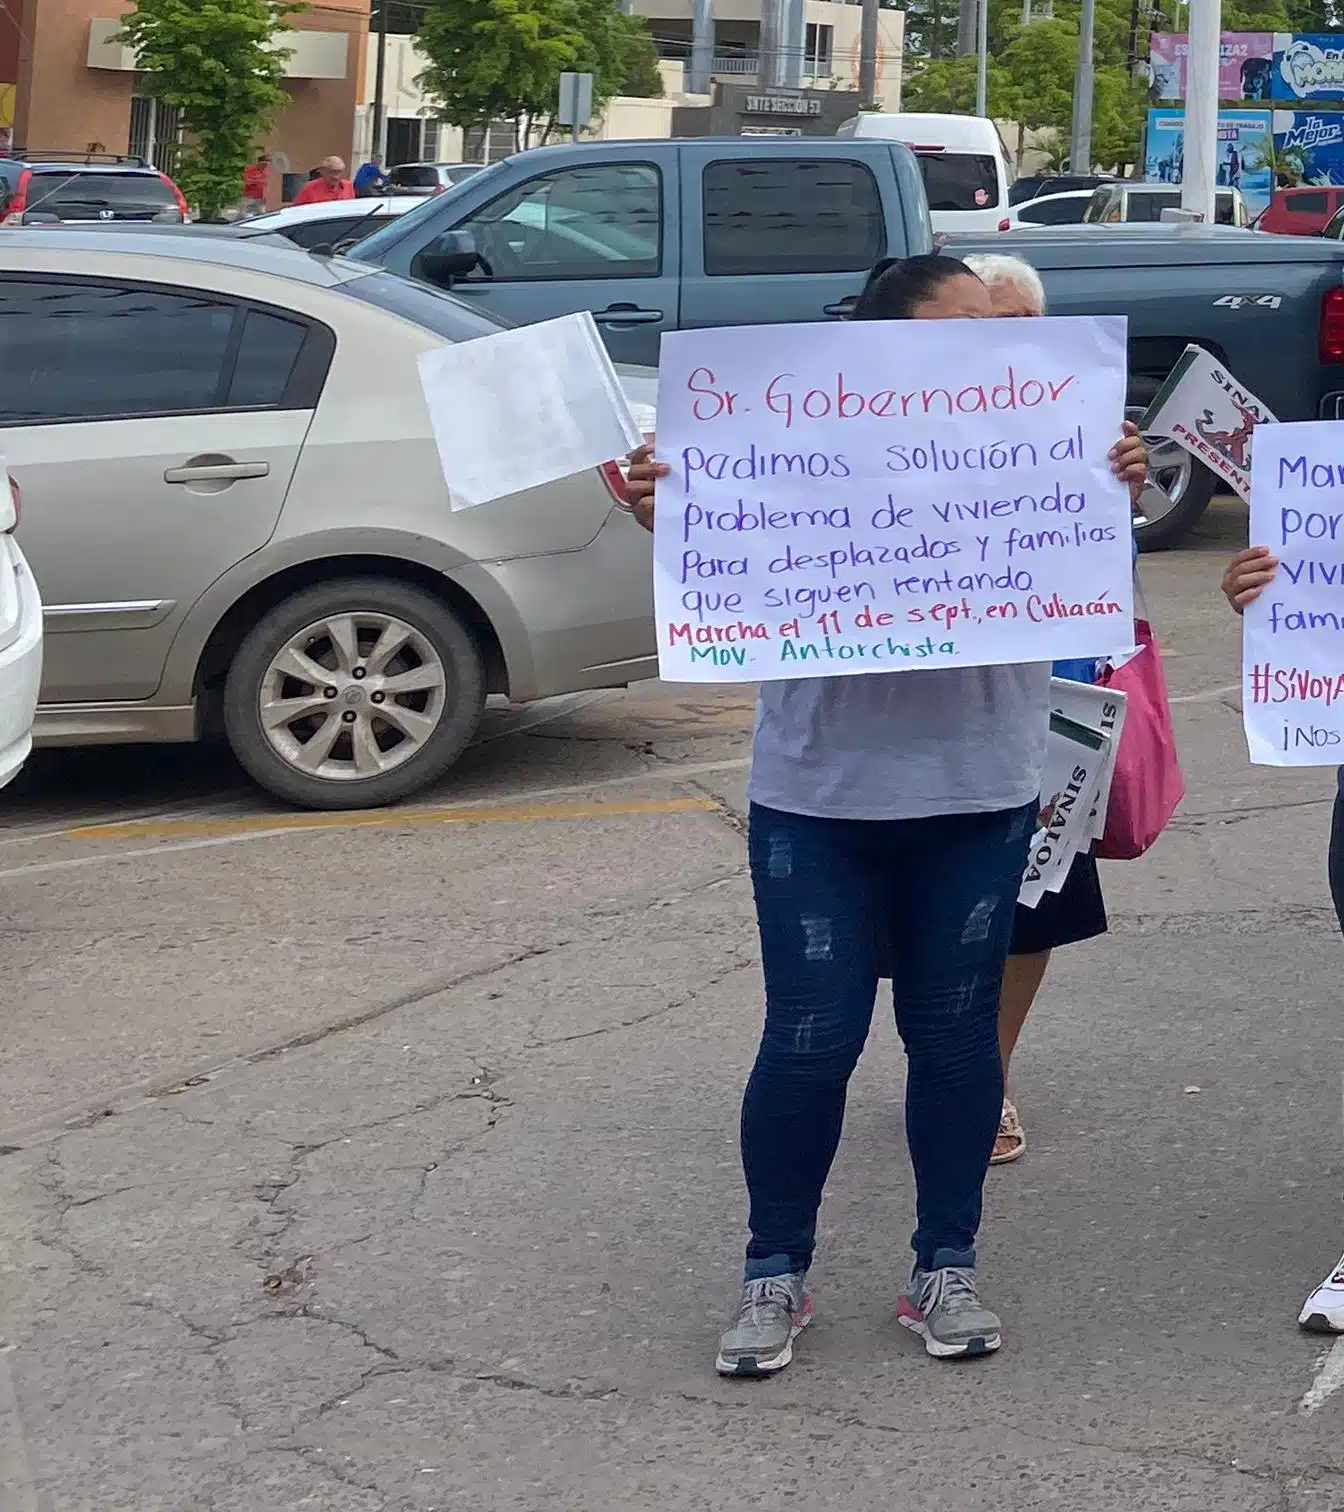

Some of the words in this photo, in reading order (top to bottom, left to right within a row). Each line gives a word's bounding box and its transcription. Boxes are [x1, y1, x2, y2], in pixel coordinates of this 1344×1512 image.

[687, 367, 752, 422] Sr.
[886, 439, 1037, 473] solución
[1050, 426, 1083, 461] al
[1172, 423, 1251, 493] PRESENT
[871, 494, 914, 531] de
[932, 488, 1086, 523] vivienda
[1280, 506, 1343, 546] por
[769, 534, 961, 578] desplazados
[1003, 522, 1116, 558] familias
[669, 621, 770, 647] Marcha
[778, 619, 799, 639] el
[817, 608, 841, 636] 11
[855, 604, 893, 628] de
[988, 600, 1016, 621] en
[1026, 590, 1123, 623] Culiacán
[681, 590, 743, 623] que
[764, 580, 876, 620] siguen
[894, 566, 1033, 596] rentando
[1023, 764, 1088, 883] SINALOA
